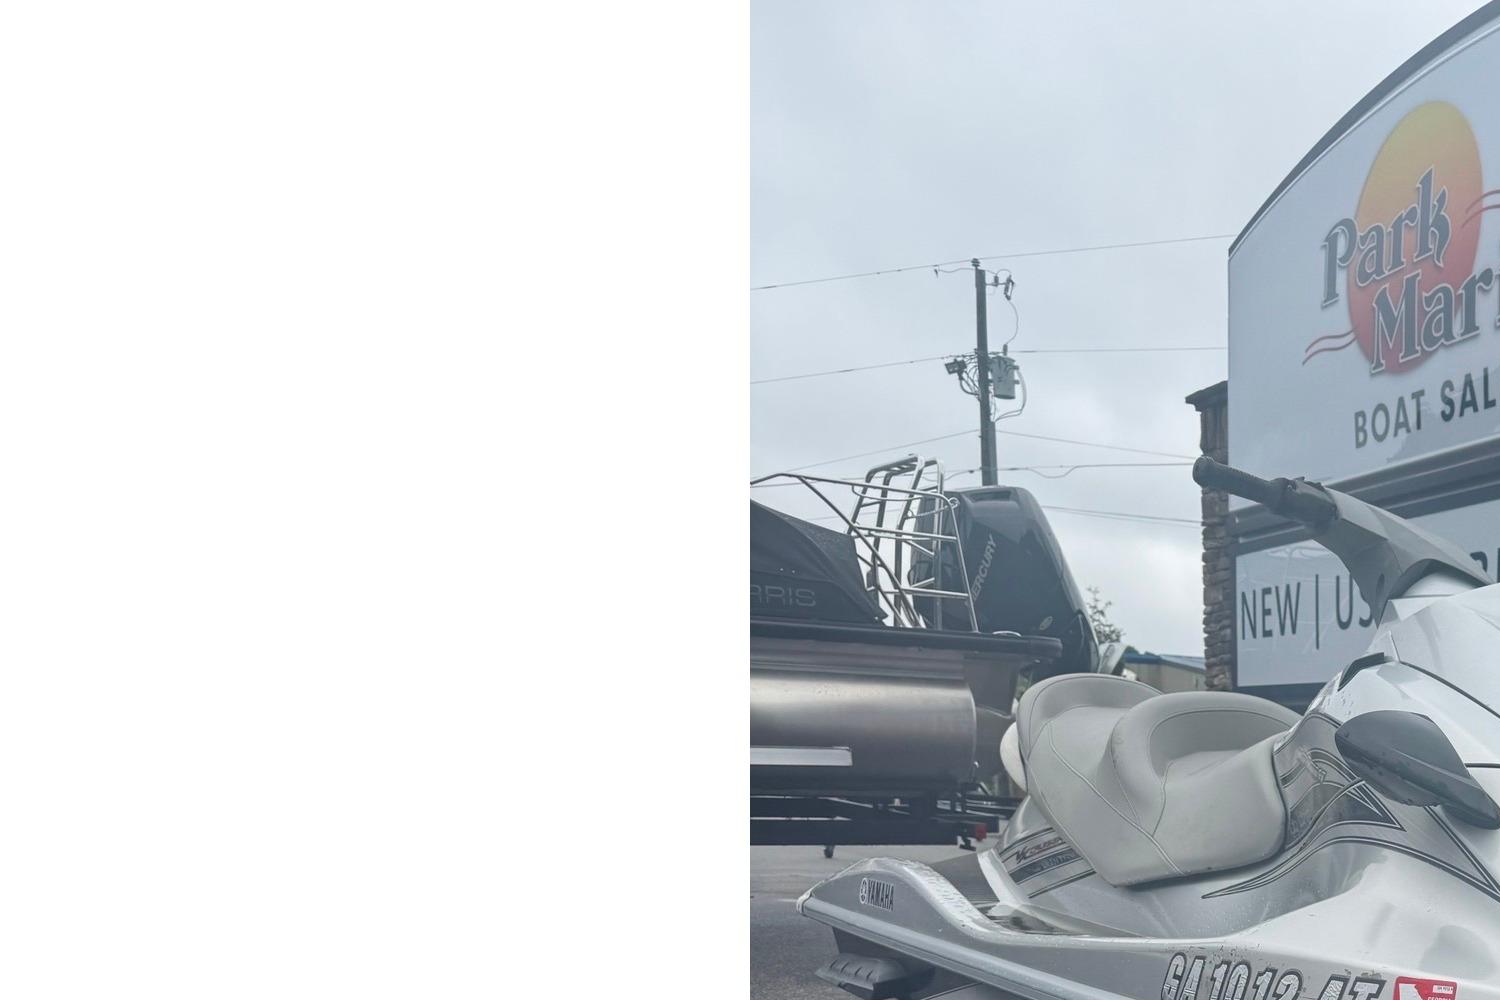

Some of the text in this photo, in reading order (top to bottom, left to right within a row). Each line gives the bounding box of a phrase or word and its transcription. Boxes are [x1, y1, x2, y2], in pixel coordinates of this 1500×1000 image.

[1322, 165, 1452, 309] Park
[1354, 389, 1425, 449] BOAT
[1241, 581, 1301, 640] NEW
[867, 879, 895, 911] YAMAHA
